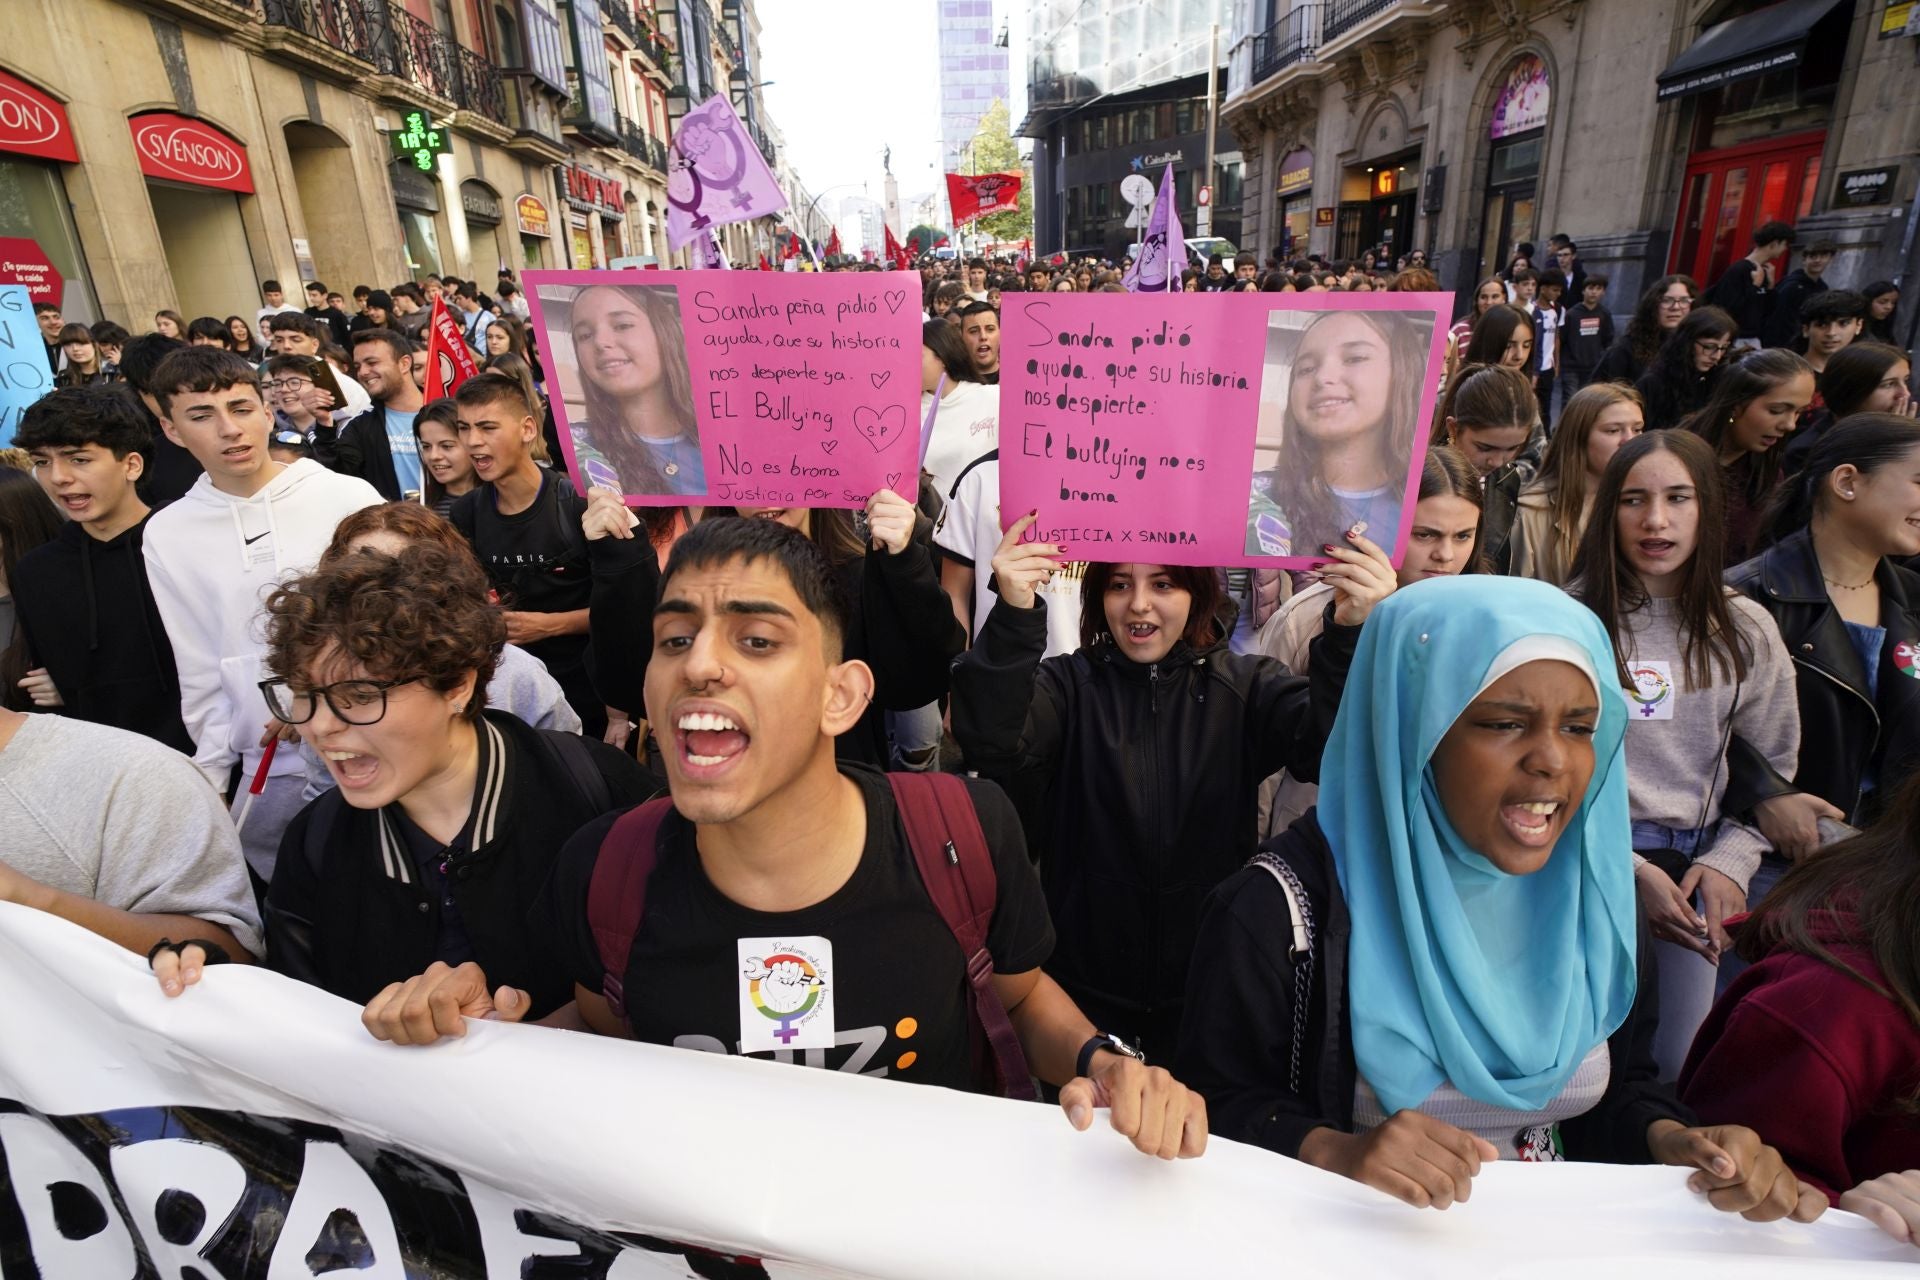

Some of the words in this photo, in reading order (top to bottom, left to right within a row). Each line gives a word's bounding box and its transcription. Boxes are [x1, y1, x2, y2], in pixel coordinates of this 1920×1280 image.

[150, 133, 231, 171] SVENSON
[694, 290, 778, 323] Sandra
[787, 299, 825, 325] peña
[837, 293, 877, 323] pidió
[703, 325, 770, 356] ayuda,
[808, 335, 822, 347] su
[832, 331, 901, 349] historia
[1024, 301, 1114, 348] Sandra
[1131, 320, 1193, 355] pidió
[709, 367, 739, 381] nos
[751, 361, 818, 385] despierte
[1105, 363, 1137, 389] que
[1150, 364, 1171, 383] su
[1180, 361, 1249, 390] historia
[709, 391, 738, 419] EL
[755, 391, 833, 432] Bullying
[1024, 388, 1051, 406] nos
[719, 443, 752, 476] No
[763, 462, 781, 474] es
[790, 454, 840, 477] broma
[1023, 422, 1053, 459] El
[1066, 433, 1147, 480] bullying
[1159, 456, 1180, 468] no
[1186, 458, 1205, 471] es
[712, 483, 794, 502] Justicia
[1060, 477, 1118, 503] broma
[1138, 530, 1198, 545] SANDRA
[492, 554, 543, 563] PARIS
